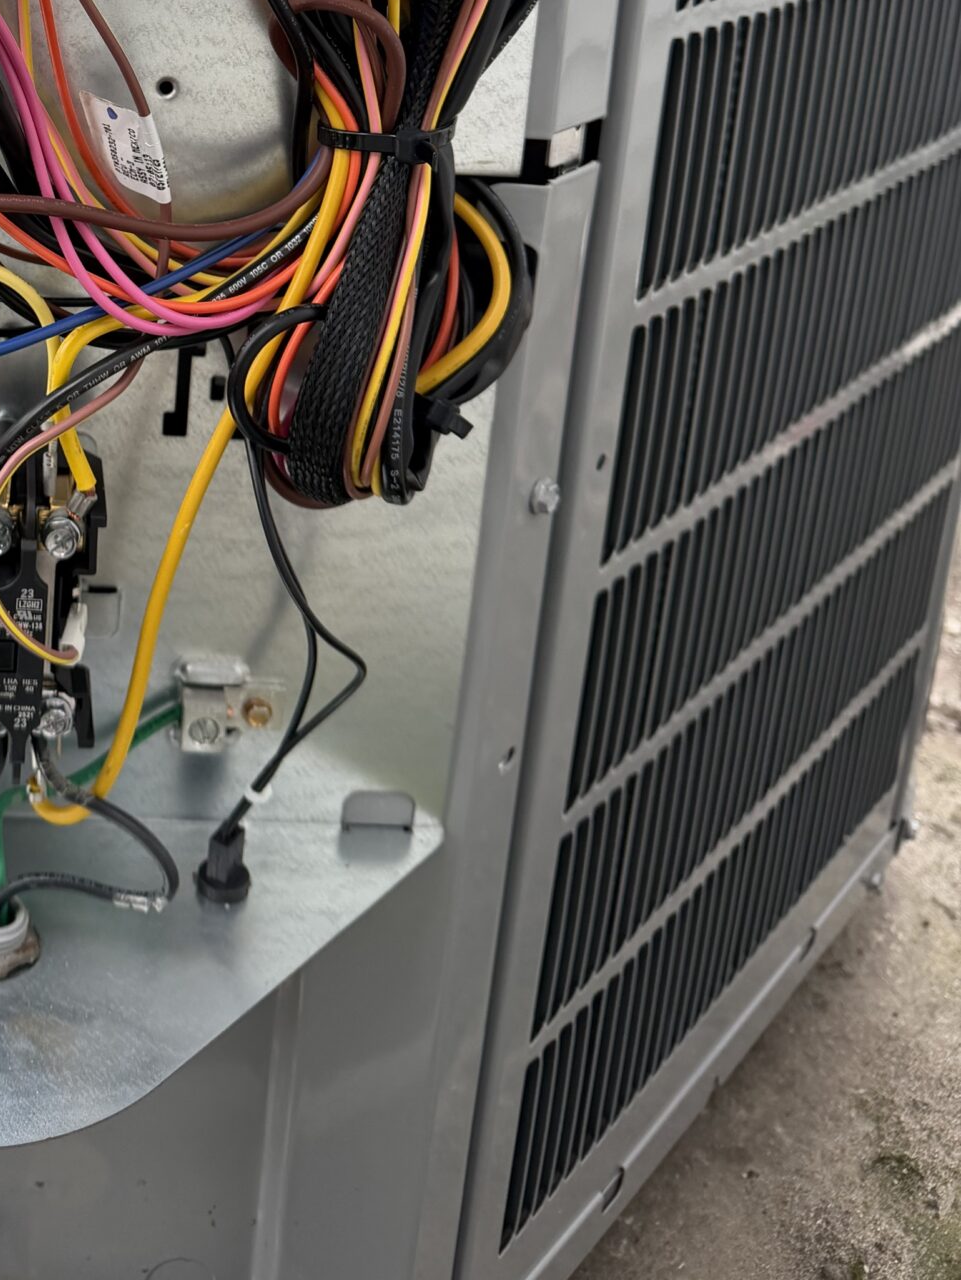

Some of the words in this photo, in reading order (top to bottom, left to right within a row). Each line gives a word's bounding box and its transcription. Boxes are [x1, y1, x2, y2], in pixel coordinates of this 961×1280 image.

[127, 128, 141, 153] MEXICO
[228, 276, 248, 294] 600V
[249, 262, 269, 279] 105C
[270, 250, 284, 263] OR
[284, 234, 303, 251] 1032
[129, 345, 151, 362] AWM
[390, 408, 403, 460] E214175
[20, 588, 35, 599] 23
[13, 705, 36, 713] CHINA
[13, 718, 27, 728] 23
